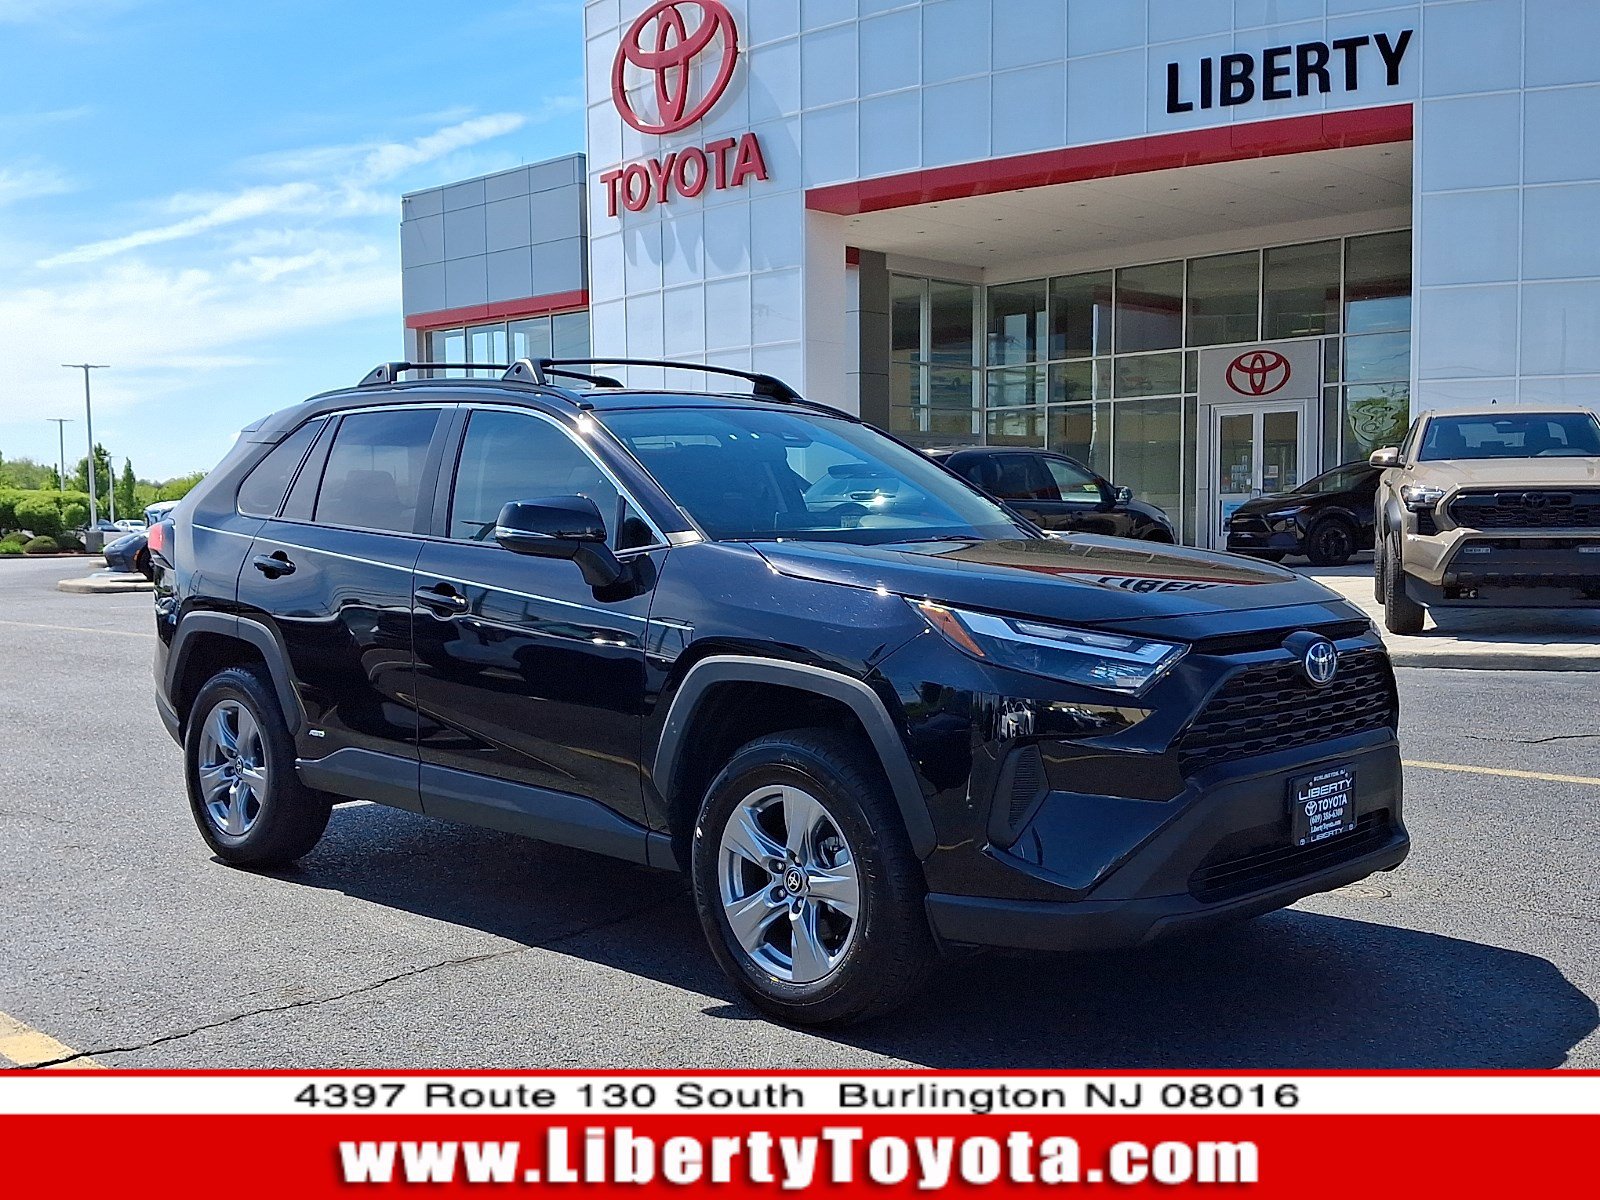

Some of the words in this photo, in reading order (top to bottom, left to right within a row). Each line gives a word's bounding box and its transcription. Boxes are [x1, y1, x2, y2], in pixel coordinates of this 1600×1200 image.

[1167, 29, 1413, 114] LIBERTY
[600, 132, 768, 217] TOYOTA
[1298, 777, 1353, 800] LIBERTY
[1318, 793, 1347, 811] TOYOTA
[1310, 827, 1344, 842] LIBERTY
